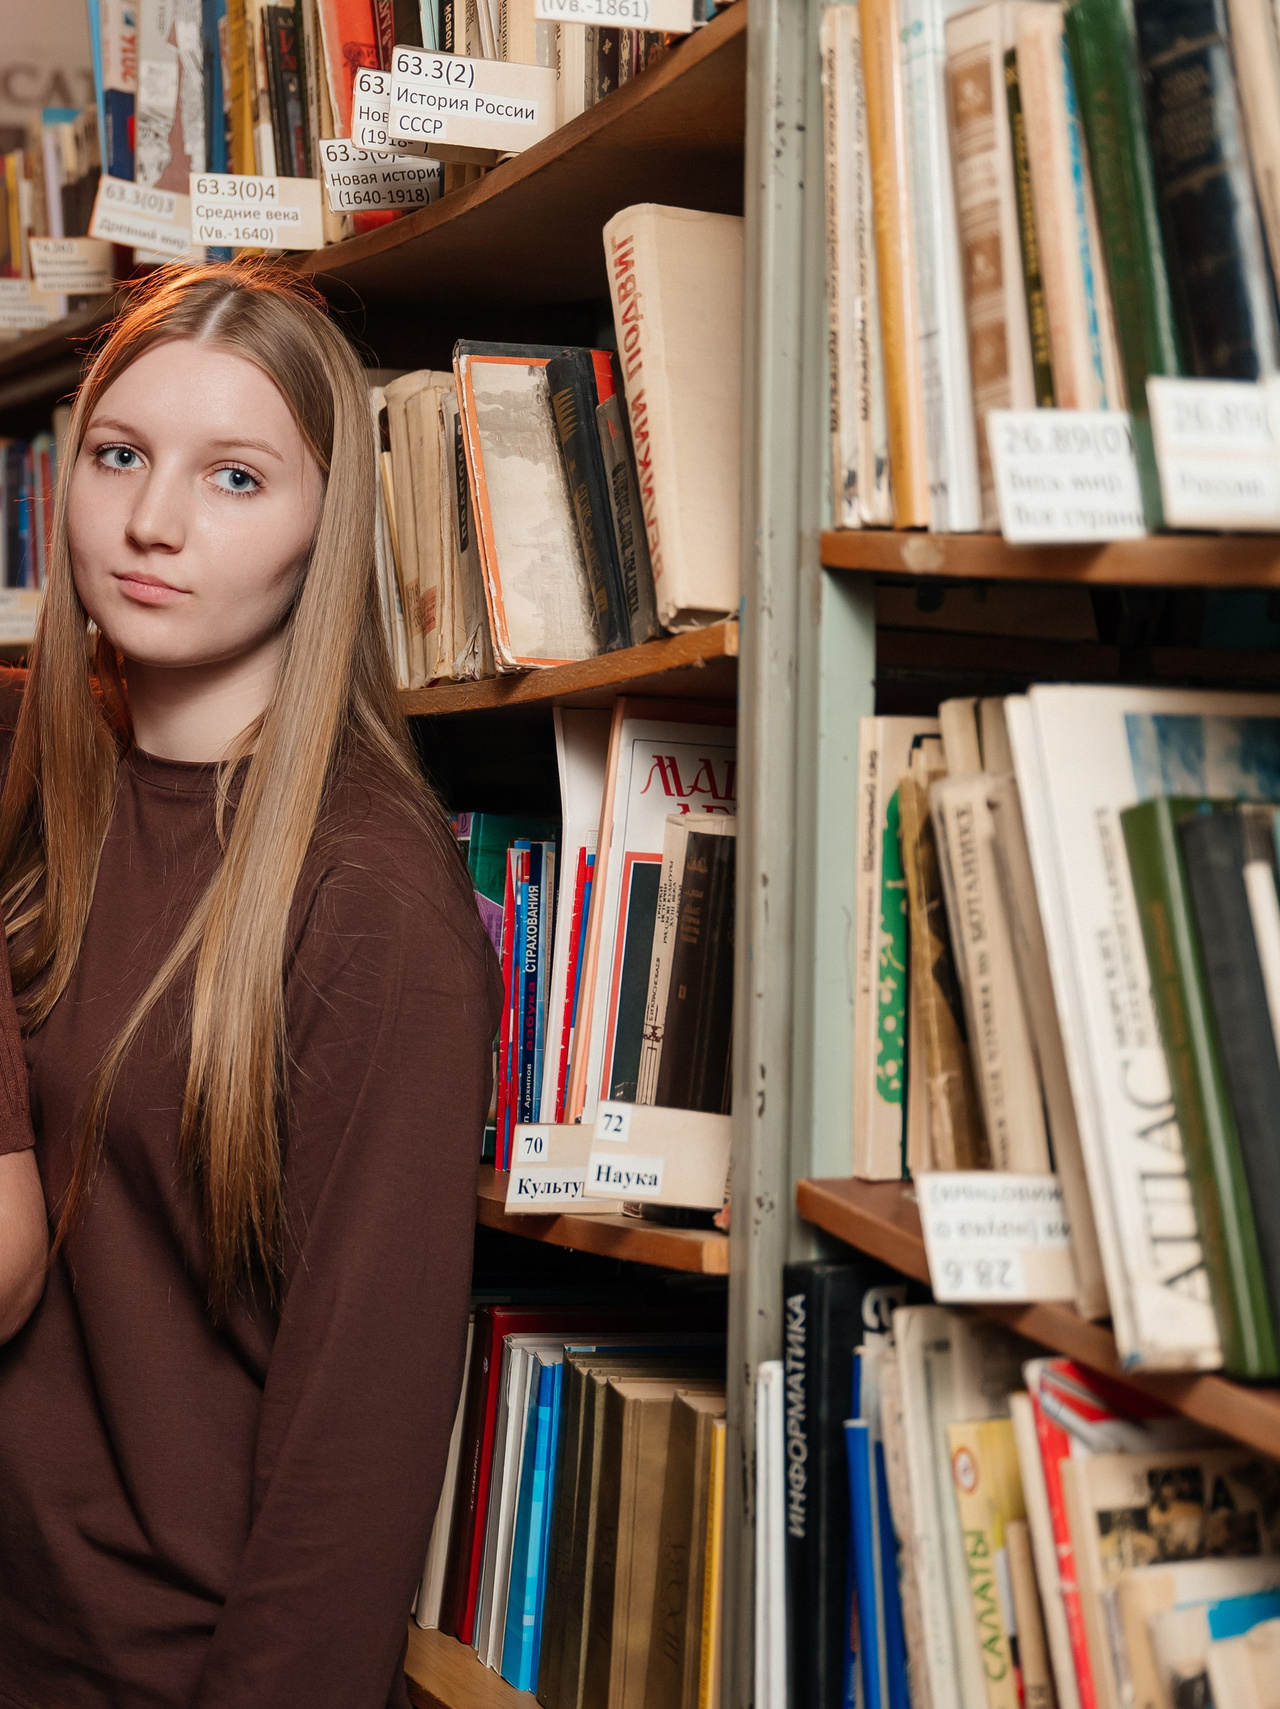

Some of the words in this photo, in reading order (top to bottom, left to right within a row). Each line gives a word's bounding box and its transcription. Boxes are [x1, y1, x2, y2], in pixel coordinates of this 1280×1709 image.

[397, 53, 475, 88] 63.3(2)
[359, 74, 390, 96] 63.
[359, 106, 389, 123] Нов
[397, 87, 469, 111] История
[475, 98, 535, 120] России
[399, 115, 443, 134] СССР
[326, 144, 406, 164] 63.3(0)
[331, 172, 377, 187] Новая
[382, 167, 440, 184] история
[197, 178, 276, 202] 63.3(0)4
[338, 187, 430, 207] (1640-1918)
[196, 205, 261, 221] Средние
[265, 209, 299, 222] века
[199, 226, 274, 242] (Vв.-1640)
[610, 233, 644, 381] ПОДВИГ
[629, 388, 664, 582] ВЕЛИКИЙ
[524, 884, 539, 973] СТРАХОВАНИЯ
[524, 981, 535, 1051] азбука
[524, 1063, 532, 1103] Архипов
[604, 1113, 624, 1132] 72
[524, 1137, 543, 1154] 70
[596, 1164, 658, 1189] Наука
[787, 1293, 807, 1538] ИНФОРМАТИКА
[963, 1528, 1007, 1683] САЛАТЫ
